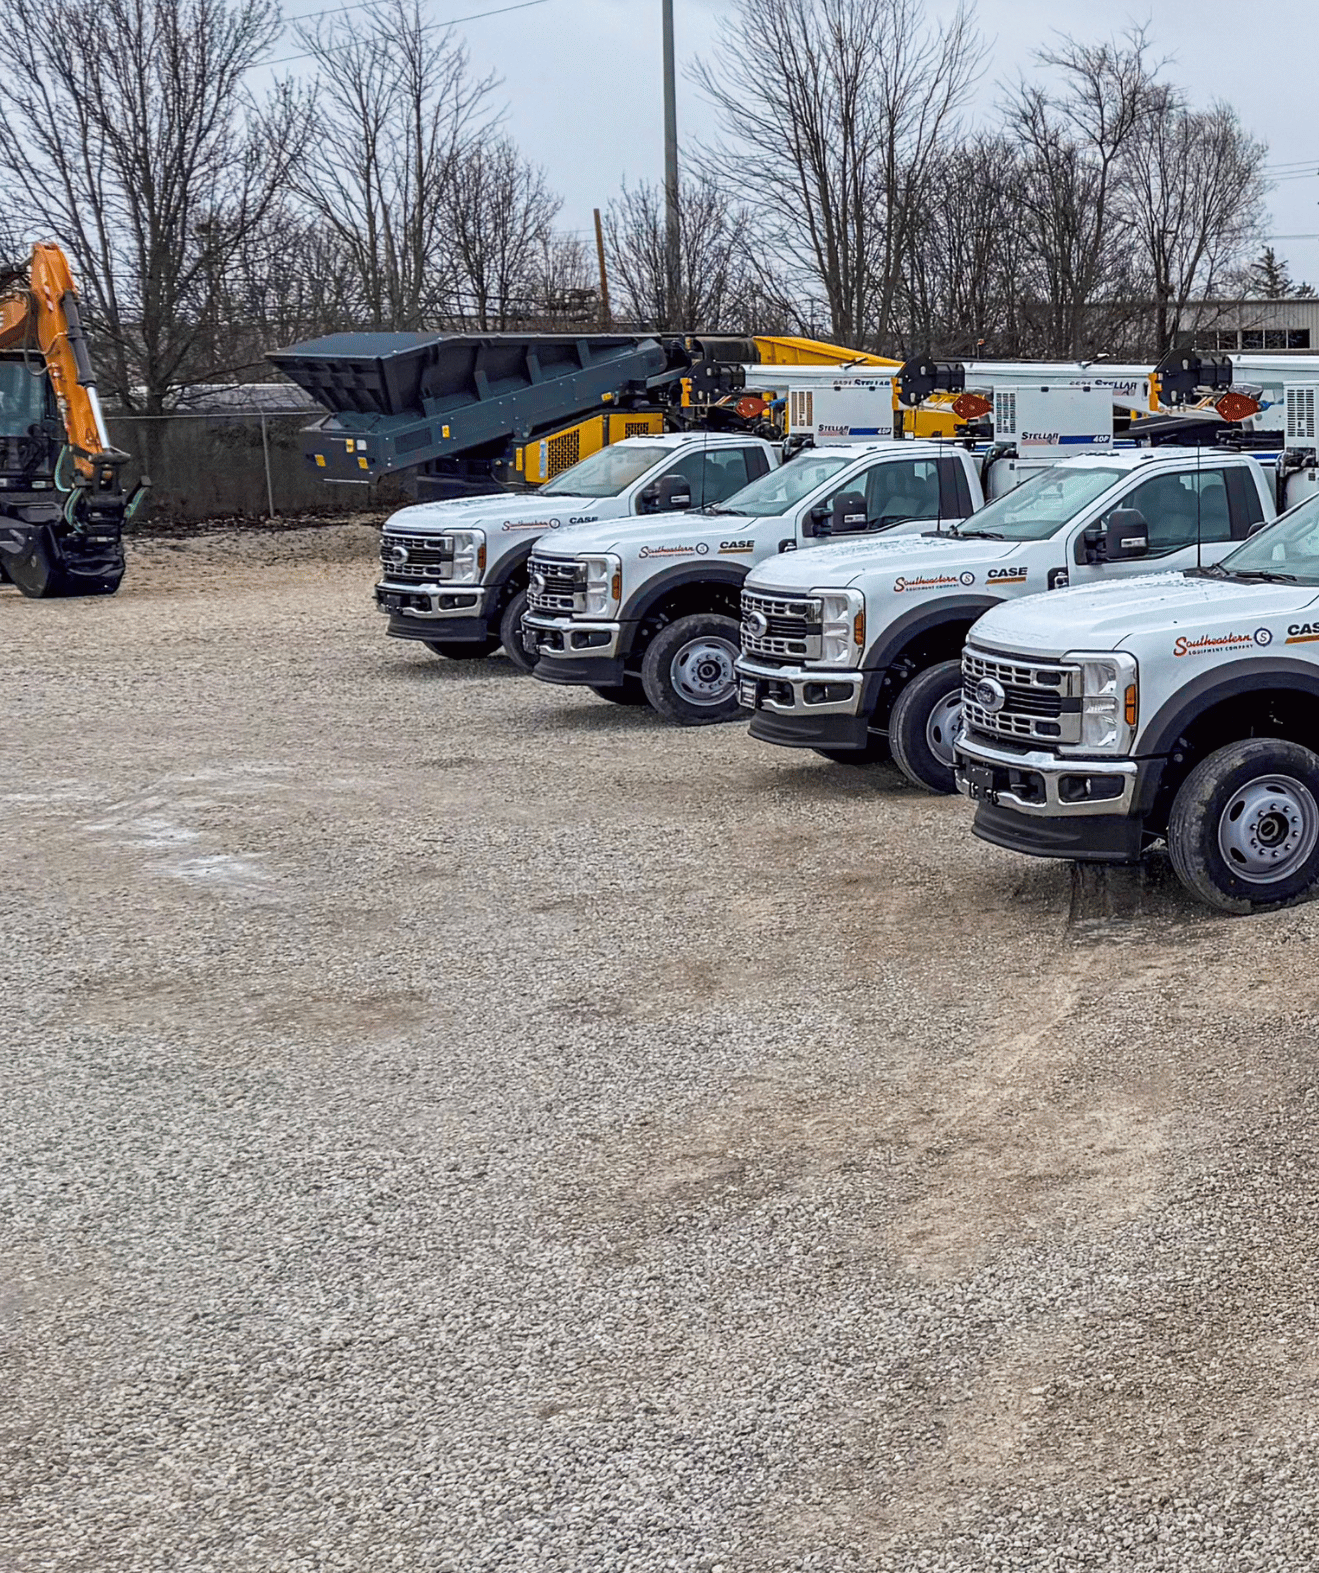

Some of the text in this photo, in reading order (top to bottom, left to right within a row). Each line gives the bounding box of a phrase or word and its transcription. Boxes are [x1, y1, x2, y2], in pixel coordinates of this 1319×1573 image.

[817, 424, 849, 434] STELLAR
[1021, 431, 1111, 444] STELLAR 40P
[720, 540, 755, 549] CASE
[988, 567, 1028, 578] CASE
[893, 574, 958, 593] Southeastern
[1173, 631, 1253, 657] Southeastern
[1188, 644, 1254, 656] EQUIPMENT COMPANY
